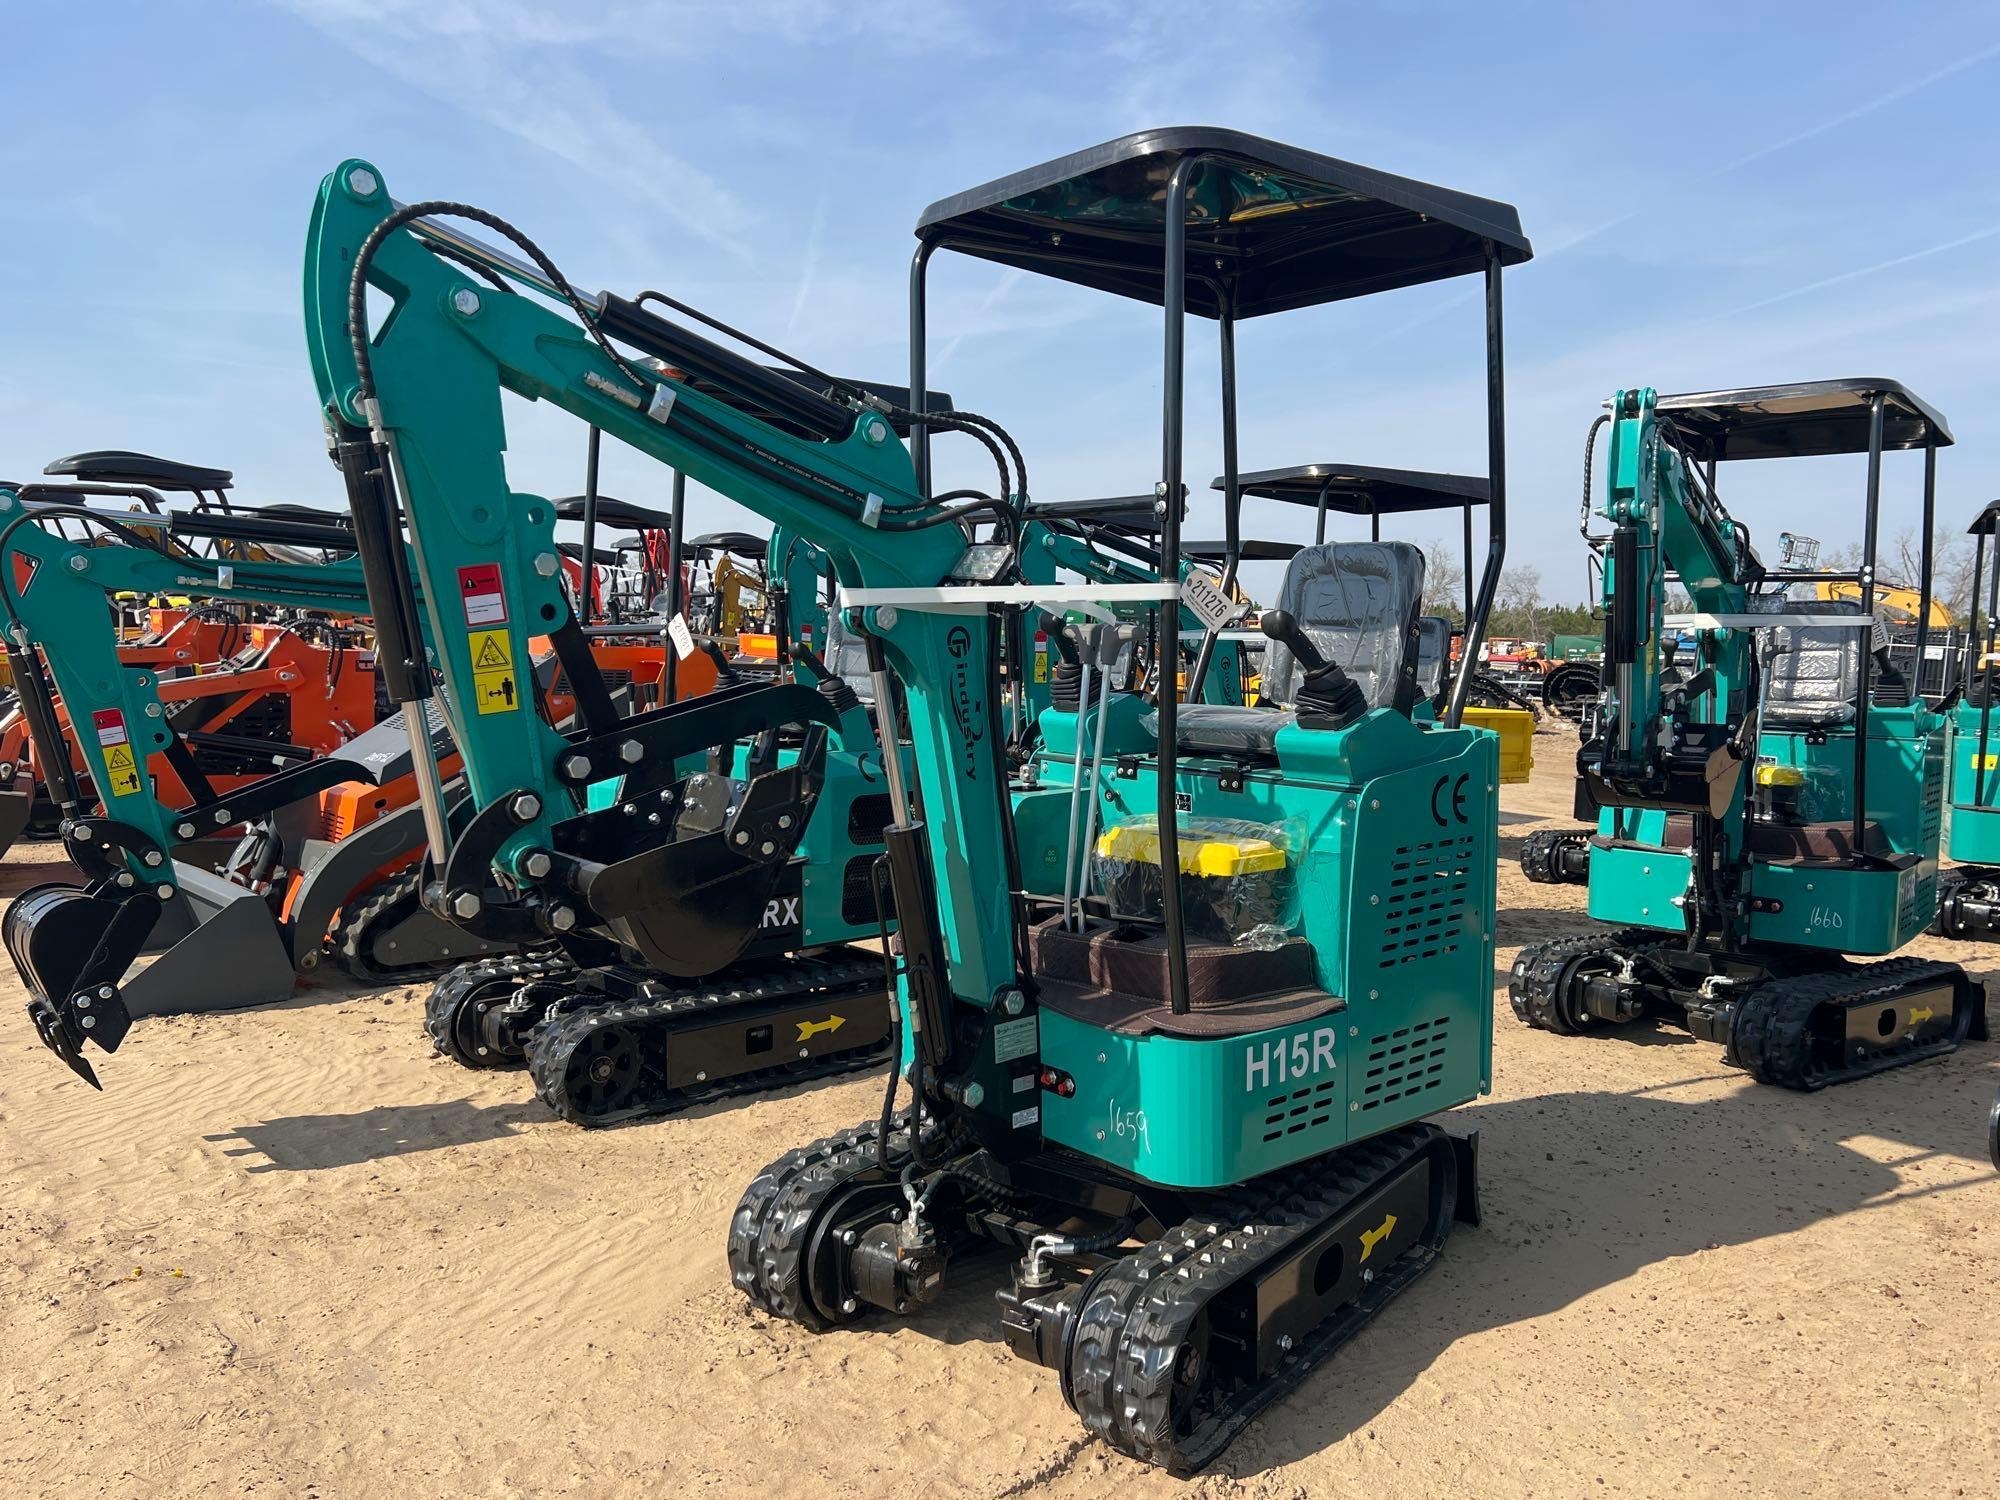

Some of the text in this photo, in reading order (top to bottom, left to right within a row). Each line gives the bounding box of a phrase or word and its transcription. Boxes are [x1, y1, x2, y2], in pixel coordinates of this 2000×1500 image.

[1191, 580, 1228, 618] 211276
[1431, 772, 1470, 827] CE
[758, 897, 799, 929] RX
[1810, 905, 1843, 928] 1660
[1246, 1027, 1337, 1092] H15R
[1109, 1097, 1153, 1157] 1659
